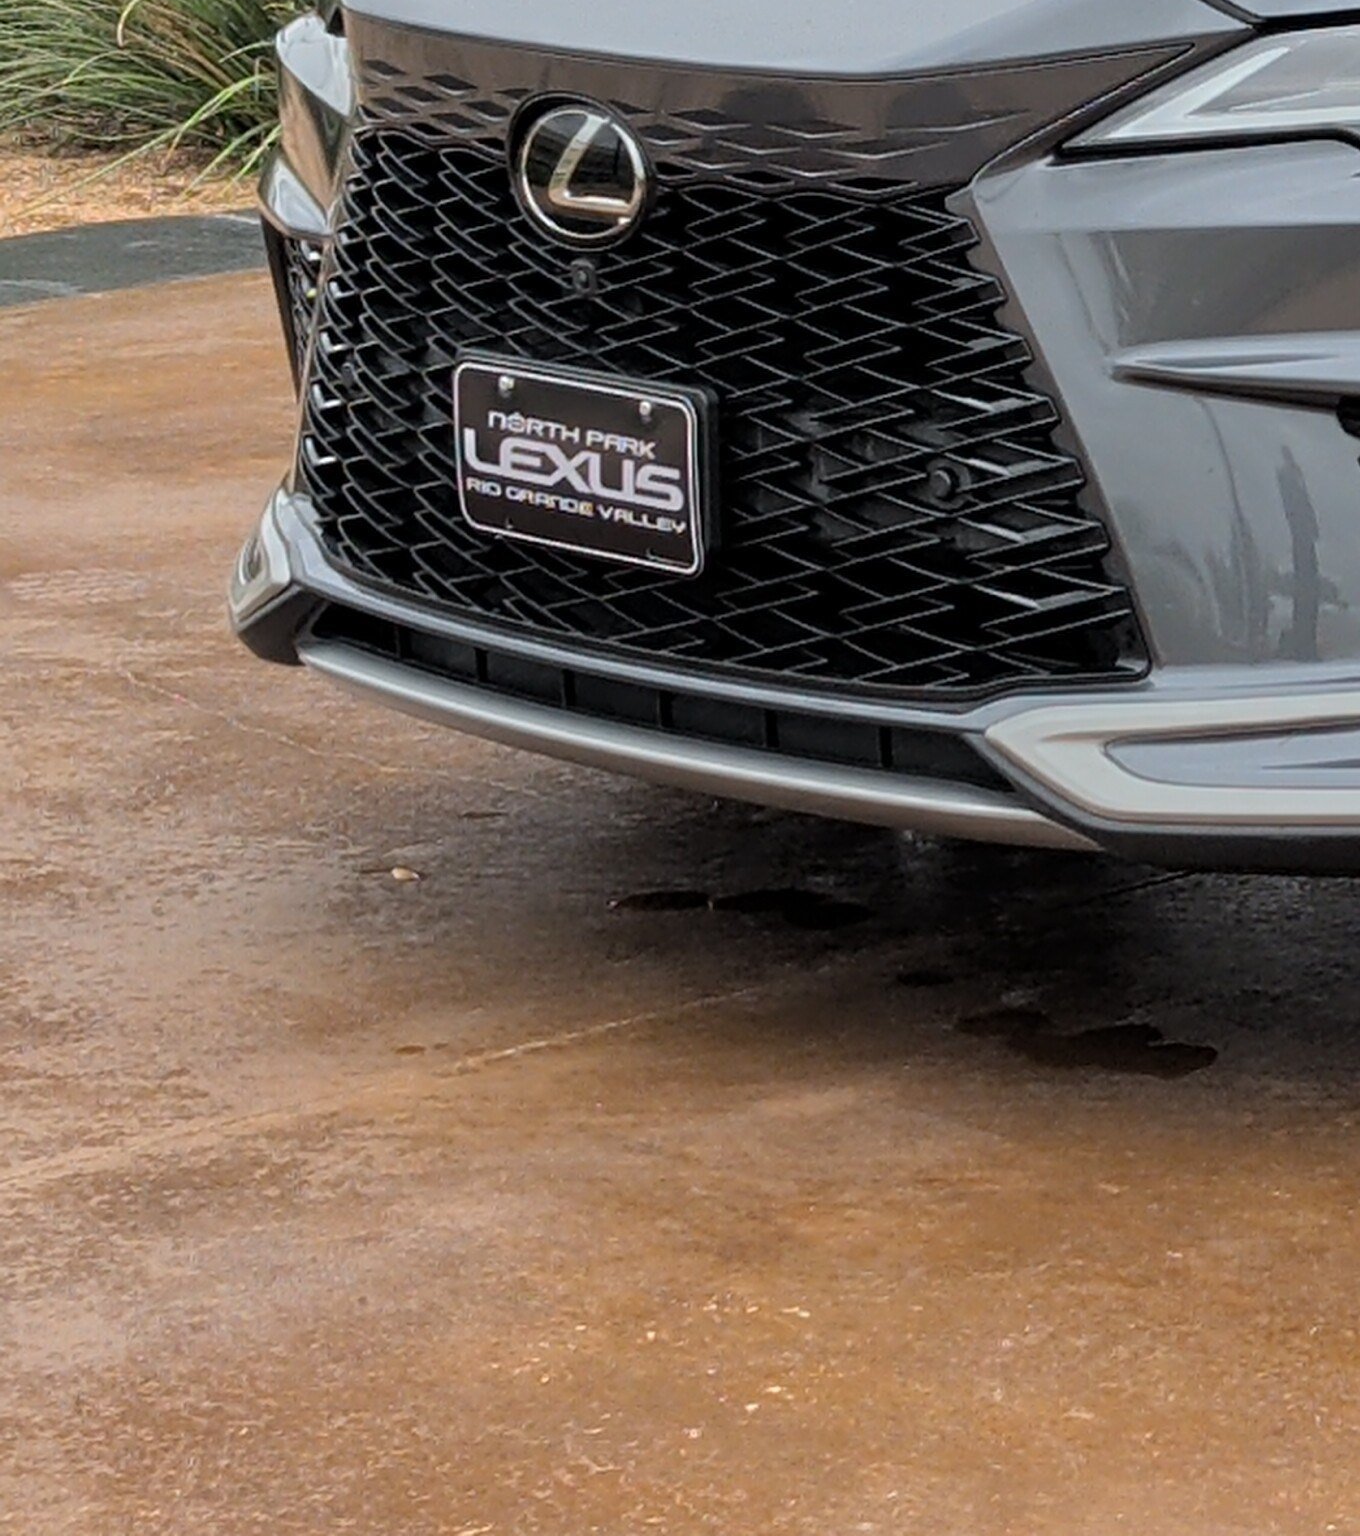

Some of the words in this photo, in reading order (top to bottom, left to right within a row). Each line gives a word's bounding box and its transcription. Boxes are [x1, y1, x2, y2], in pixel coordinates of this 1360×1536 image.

[487, 410, 580, 445] NORTH
[586, 429, 656, 460] PARK
[463, 427, 684, 512] LEXUS
[466, 476, 501, 497] RIO
[506, 484, 594, 517] GRANDE
[597, 503, 687, 534] VALLEY
